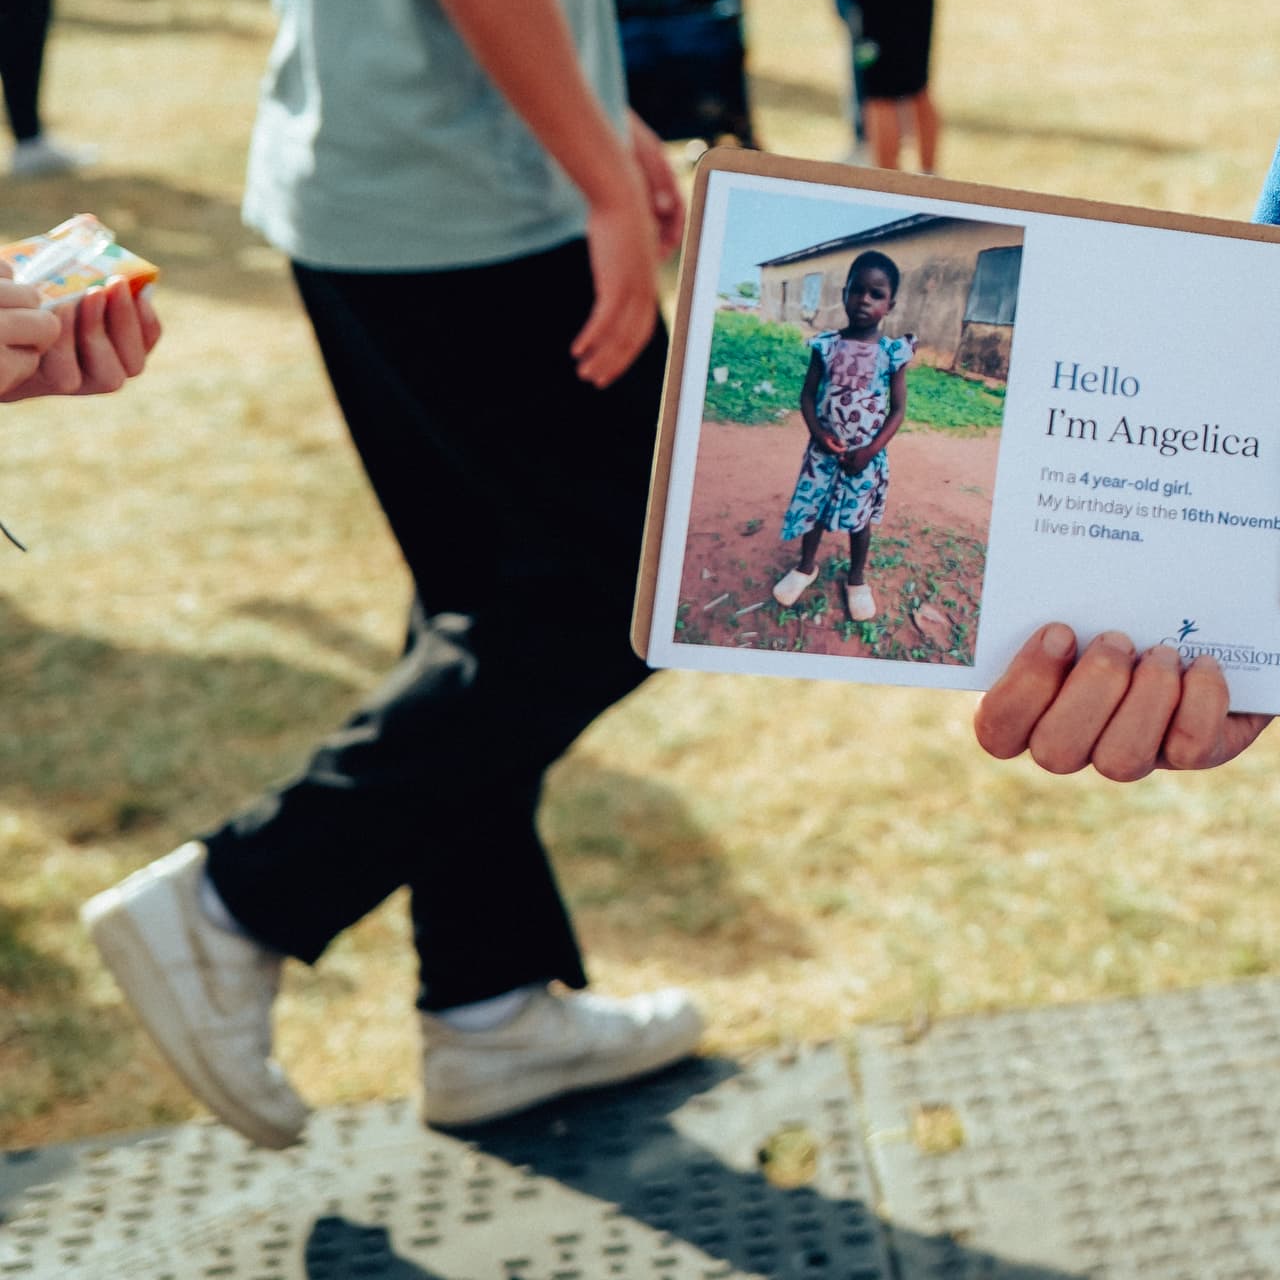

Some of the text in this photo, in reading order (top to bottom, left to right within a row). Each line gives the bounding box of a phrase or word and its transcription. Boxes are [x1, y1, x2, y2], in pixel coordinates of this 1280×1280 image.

[1051, 361, 1140, 398] Hello
[1108, 416, 1260, 458] Angelica
[1067, 473, 1077, 485] a
[1079, 471, 1090, 486] 4
[1091, 473, 1159, 493] year-old
[1163, 479, 1192, 497] girl.
[1037, 493, 1063, 513] My
[1065, 496, 1133, 519] birthday
[1136, 502, 1149, 517] is
[1152, 505, 1178, 520] the
[1181, 507, 1214, 524] 16th
[1034, 518, 1144, 542] I live in Ghana.
